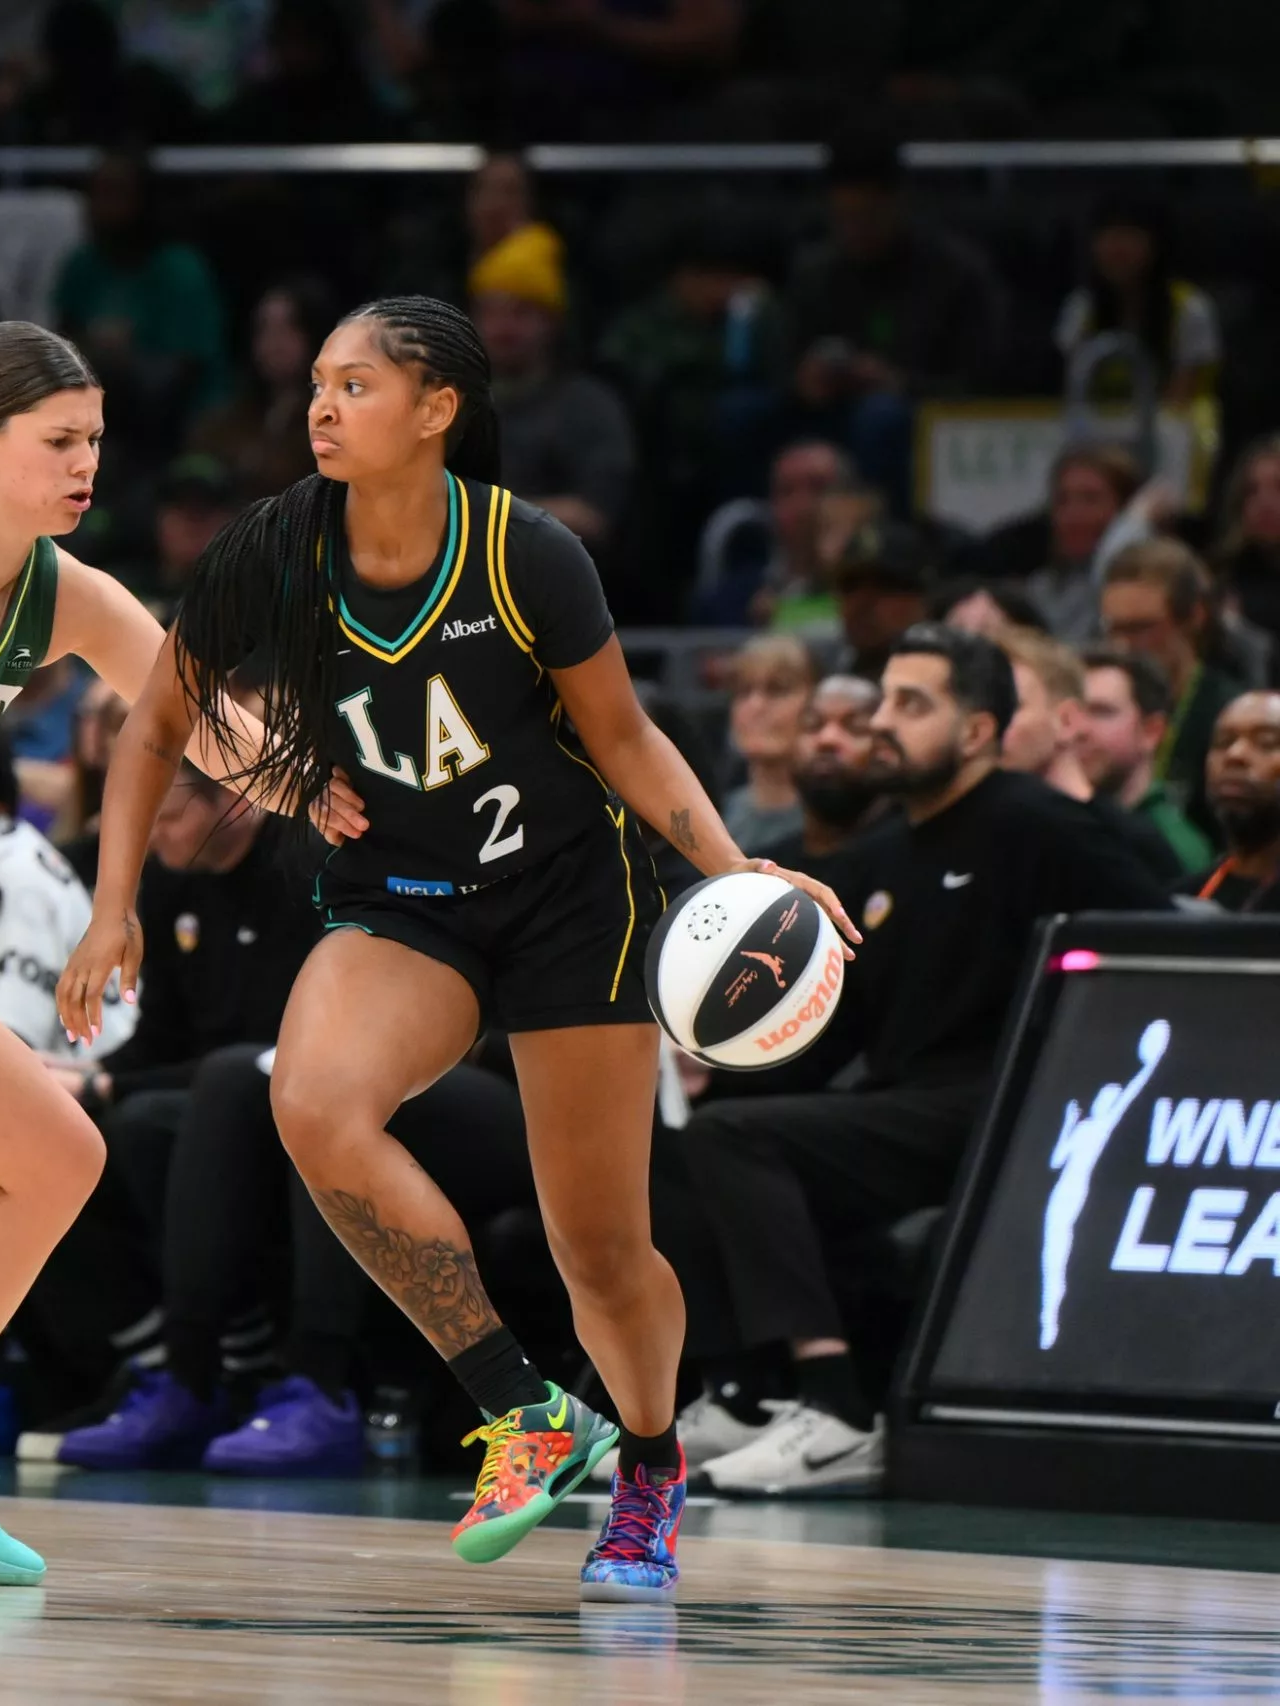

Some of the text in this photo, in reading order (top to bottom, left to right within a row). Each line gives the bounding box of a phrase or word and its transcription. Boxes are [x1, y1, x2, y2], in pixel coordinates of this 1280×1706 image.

[441, 614, 497, 641] Albert
[335, 672, 491, 792] LA
[473, 784, 523, 864] 2
